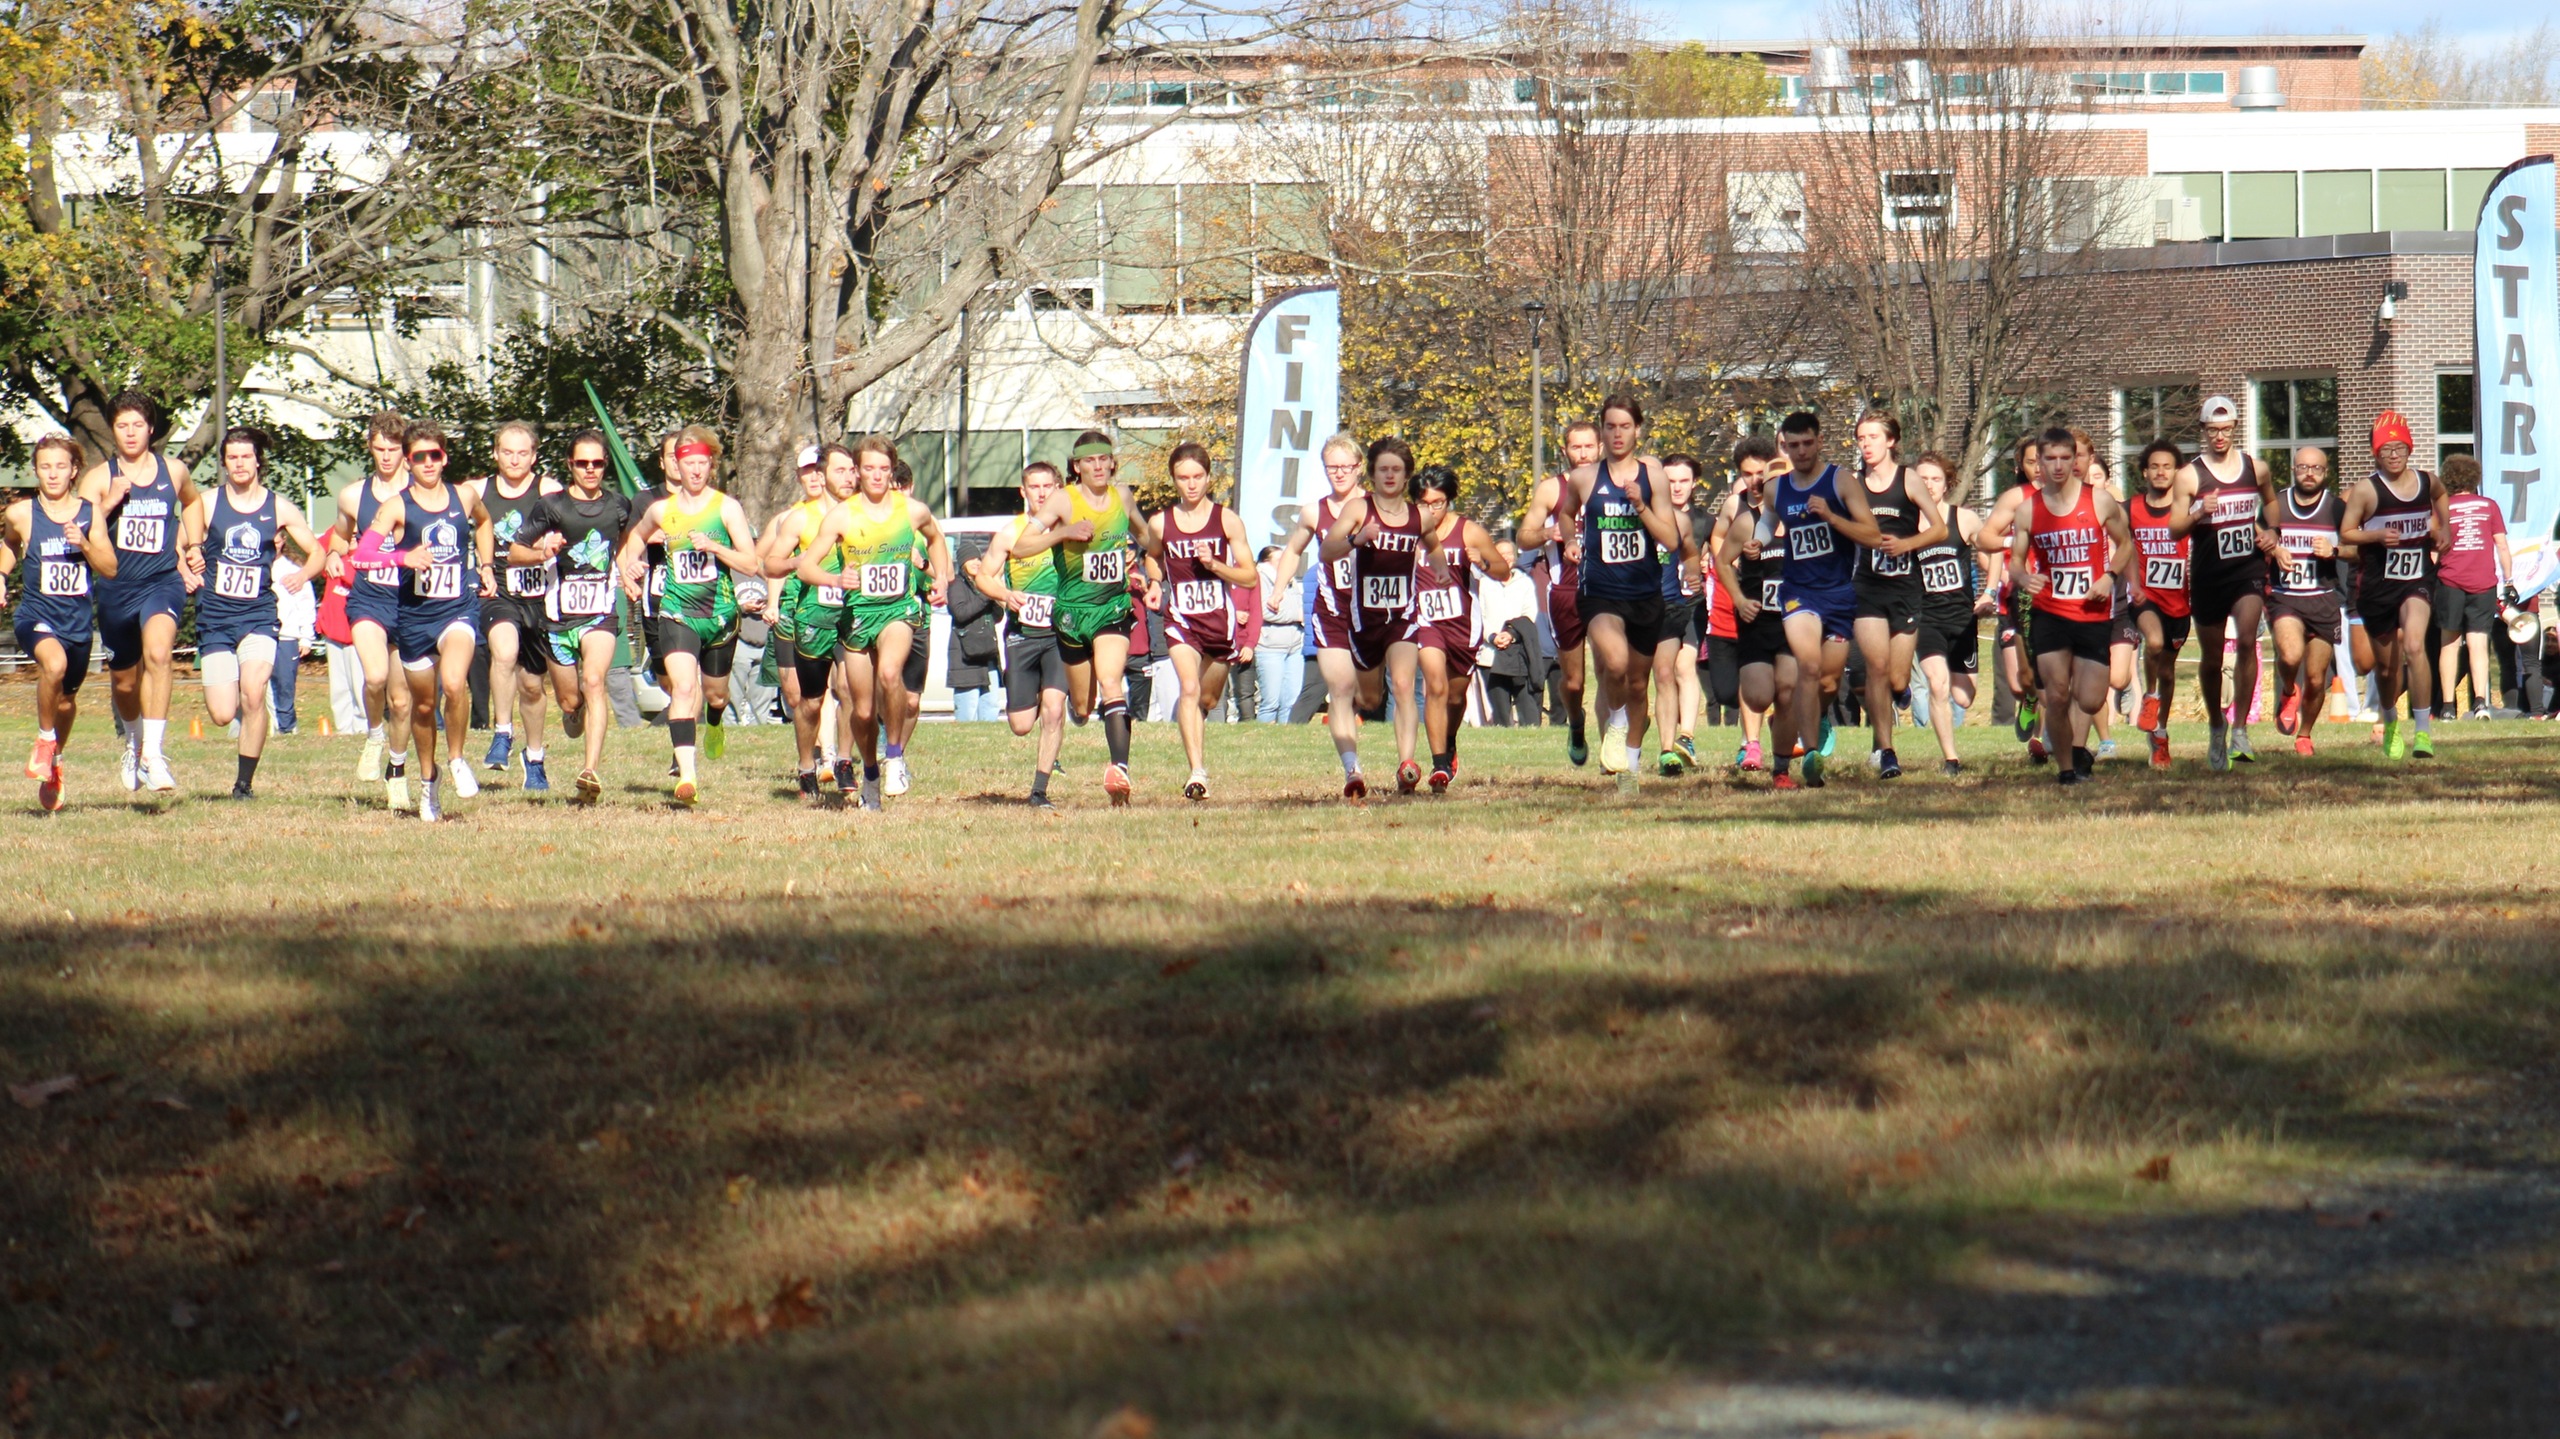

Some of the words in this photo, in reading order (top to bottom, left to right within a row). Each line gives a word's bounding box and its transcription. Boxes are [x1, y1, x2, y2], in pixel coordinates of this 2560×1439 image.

[2492, 195, 2541, 523] START
[1604, 503, 1638, 516] UMA
[125, 519, 157, 550] 384
[1166, 537, 1221, 559] NHTI
[1609, 533, 1639, 560] 336
[1793, 526, 1831, 556] 298
[2034, 528, 2097, 549] CENTRAL
[2134, 528, 2169, 541] CENTR
[2142, 542, 2177, 554] MAINE
[2220, 527, 2252, 555] 263
[847, 545, 873, 556] Paul
[1760, 549, 1786, 560] HAMPS
[1918, 546, 1957, 561] HAMPSHIRE
[2047, 546, 2089, 564] MAINE
[50, 564, 80, 592] 382
[680, 552, 709, 581] 362
[1089, 553, 1117, 580] 363
[1924, 562, 1959, 589] 289
[2148, 560, 2182, 586] 274
[2280, 562, 2314, 585] 264
[2388, 552, 2421, 577] 267
[223, 566, 255, 595] 375
[422, 566, 453, 595] 374
[514, 567, 542, 594] 368
[869, 565, 898, 593] 358
[1370, 578, 1400, 605] 344
[2053, 570, 2090, 596] 275
[568, 584, 597, 611] 367
[1025, 596, 1053, 623] 354
[1185, 582, 1216, 610] 343
[1425, 589, 1454, 618] 341
